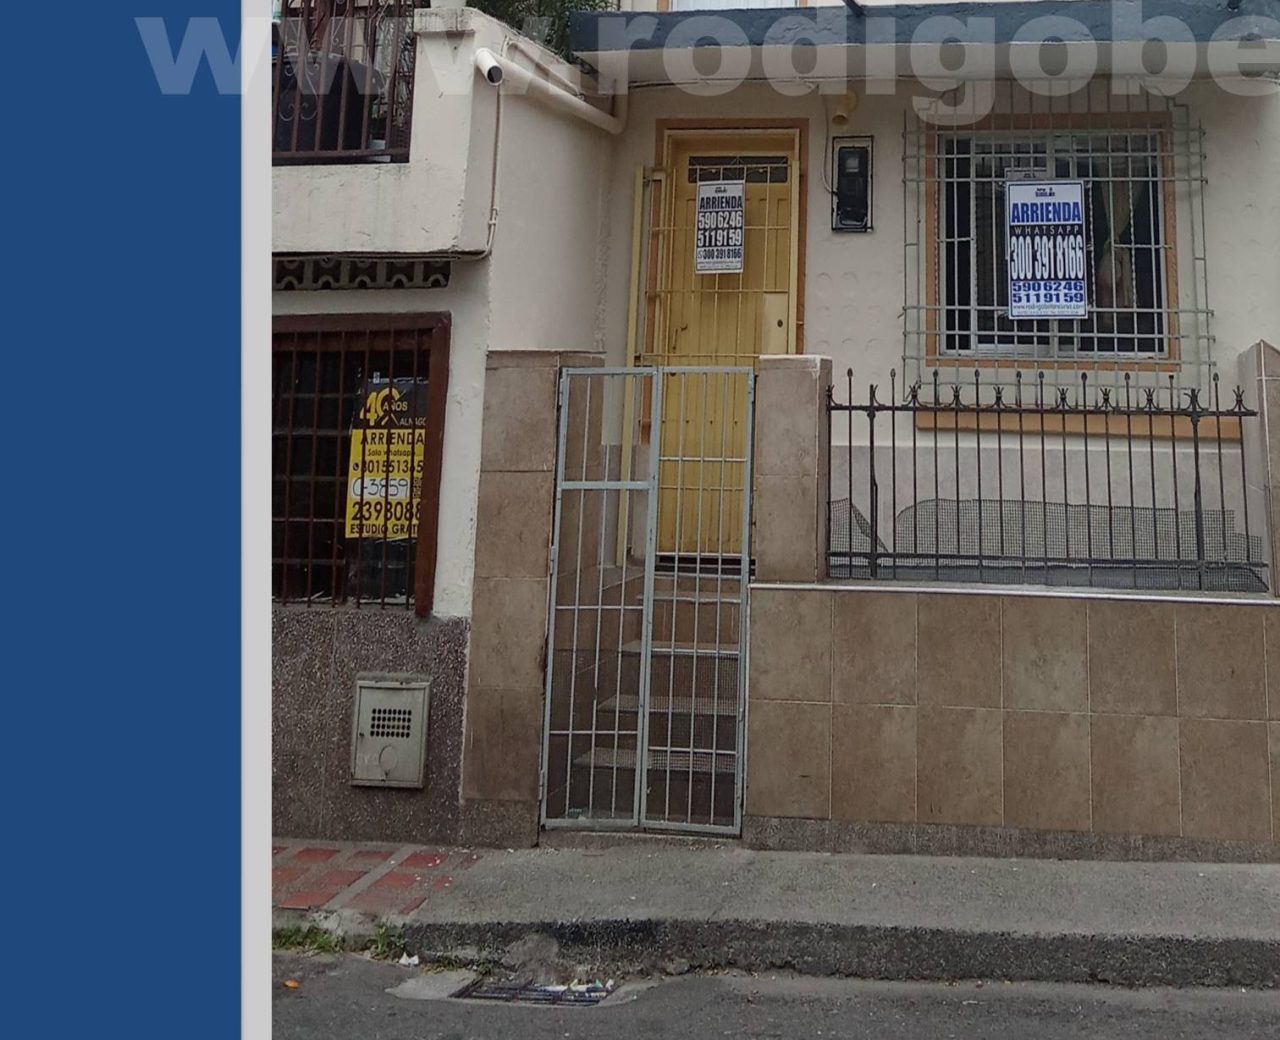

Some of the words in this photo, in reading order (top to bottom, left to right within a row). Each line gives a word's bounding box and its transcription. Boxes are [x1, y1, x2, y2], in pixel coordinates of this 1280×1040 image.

[700, 196, 743, 210] ARRIENDA
[1011, 202, 1081, 223] ARRIENDA
[1014, 225, 1079, 235] WHATSAPP
[1011, 236, 1033, 280] 300
[360, 432, 425, 445] ARRENDA
